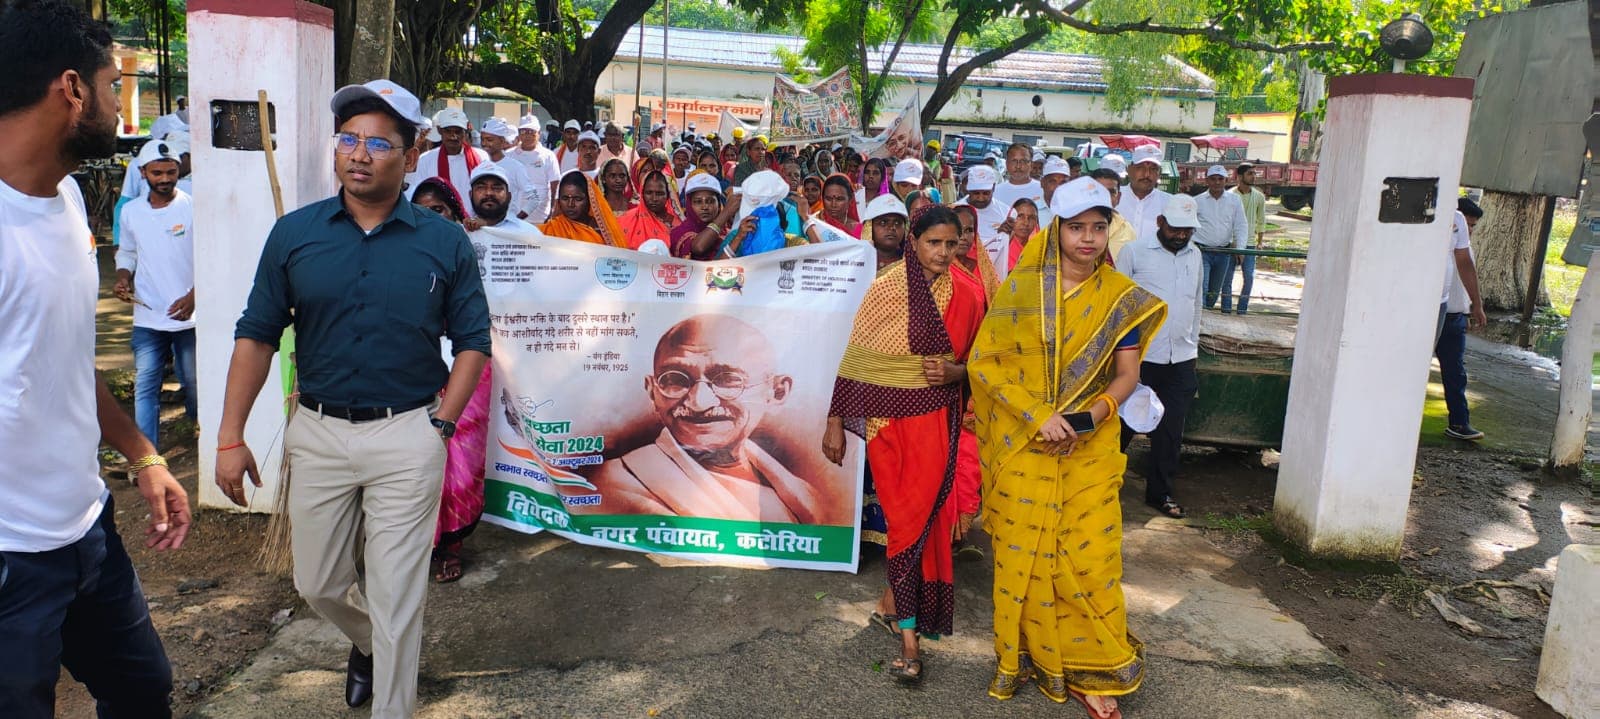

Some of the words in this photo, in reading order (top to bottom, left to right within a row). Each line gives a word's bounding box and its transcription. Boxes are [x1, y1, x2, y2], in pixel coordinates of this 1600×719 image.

[530, 312, 547, 323] भक्ति
[548, 312, 556, 322] के
[557, 314, 570, 323] बाद
[590, 314, 608, 323] स्थान
[610, 314, 620, 323] पर
[558, 326, 574, 337] शरीर
[576, 326, 583, 336] से
[526, 344, 532, 352] न
[534, 341, 541, 353] ही
[556, 343, 567, 351] मन
[583, 363, 591, 372] 19
[612, 363, 629, 372] 1925
[567, 436, 603, 453] 2024
[495, 462, 522, 476] स्वभाव
[591, 526, 639, 544] नगर
[645, 521, 724, 551] पंचायत,
[735, 527, 822, 555] कटोरिया
